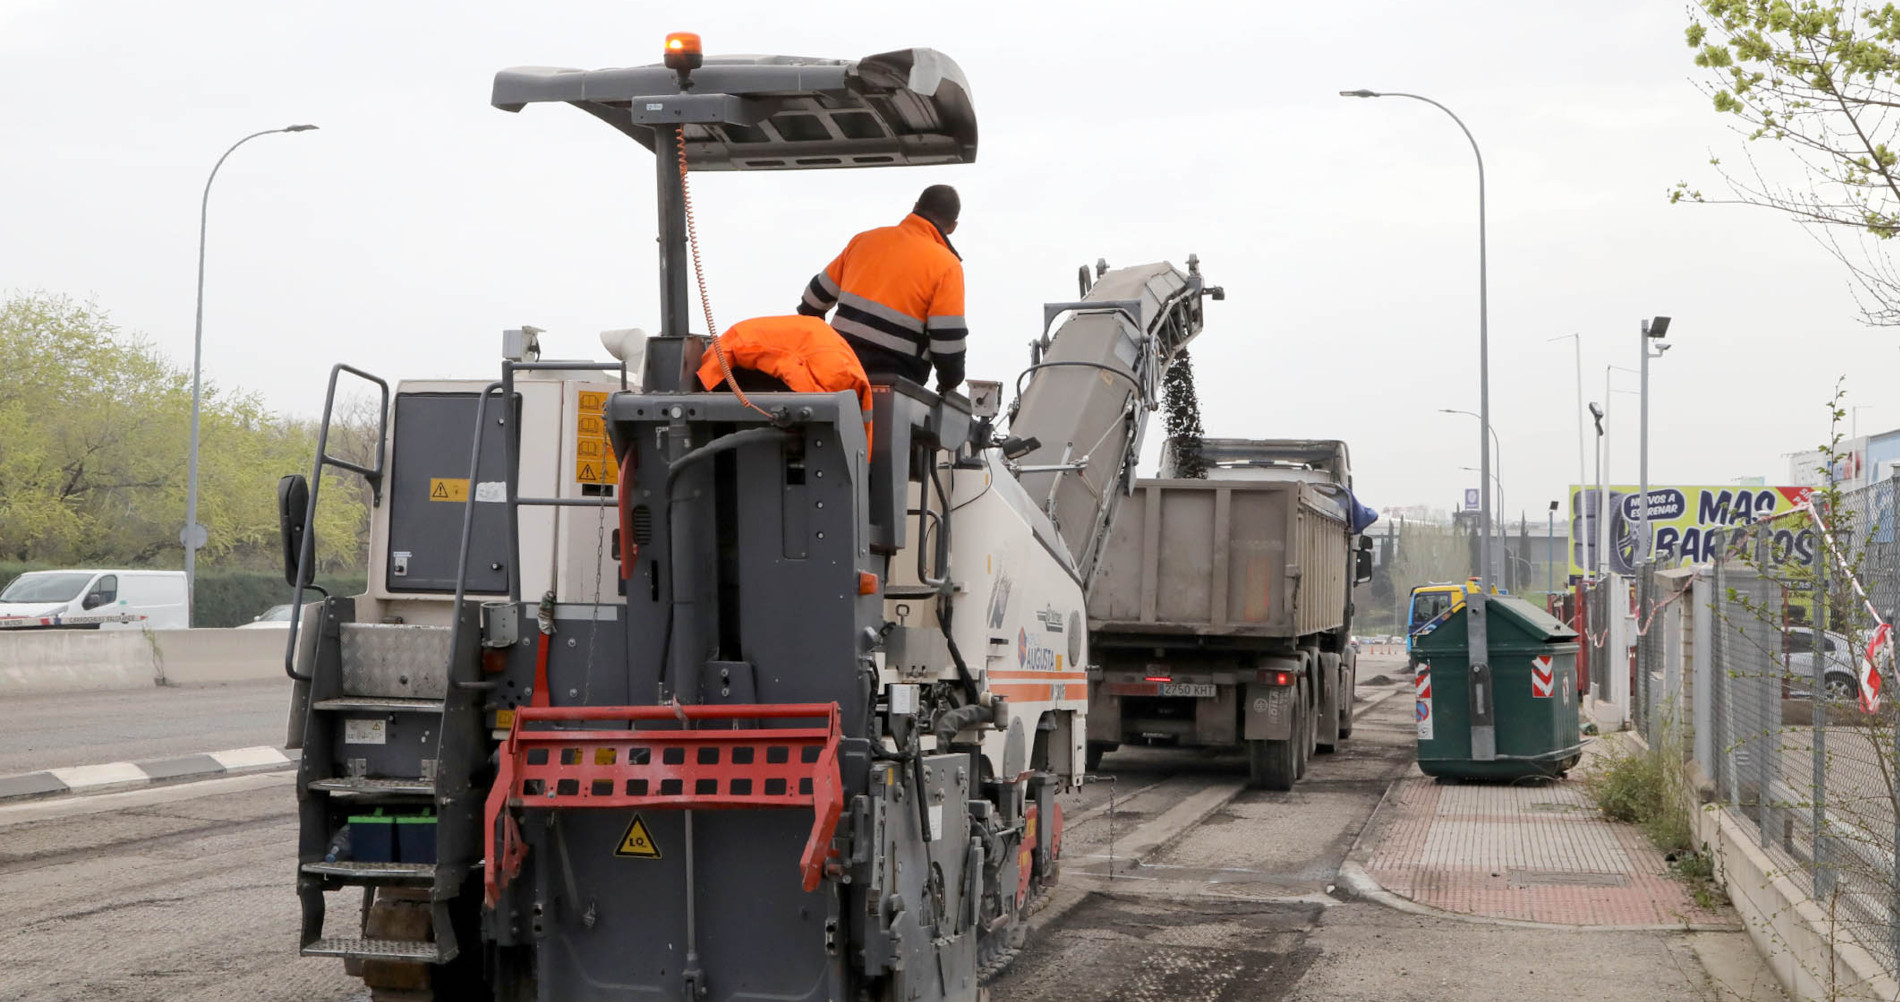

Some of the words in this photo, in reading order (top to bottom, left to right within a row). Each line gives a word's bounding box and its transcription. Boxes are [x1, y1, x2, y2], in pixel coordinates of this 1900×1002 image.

[1631, 494, 1667, 507] NVOS
[1668, 493, 1676, 503] A
[1631, 504, 1678, 518] ESRENAR
[1027, 647, 1054, 671] AUGUSTA
[1165, 684, 1190, 695] 2750
[1194, 685, 1214, 695] KHT
